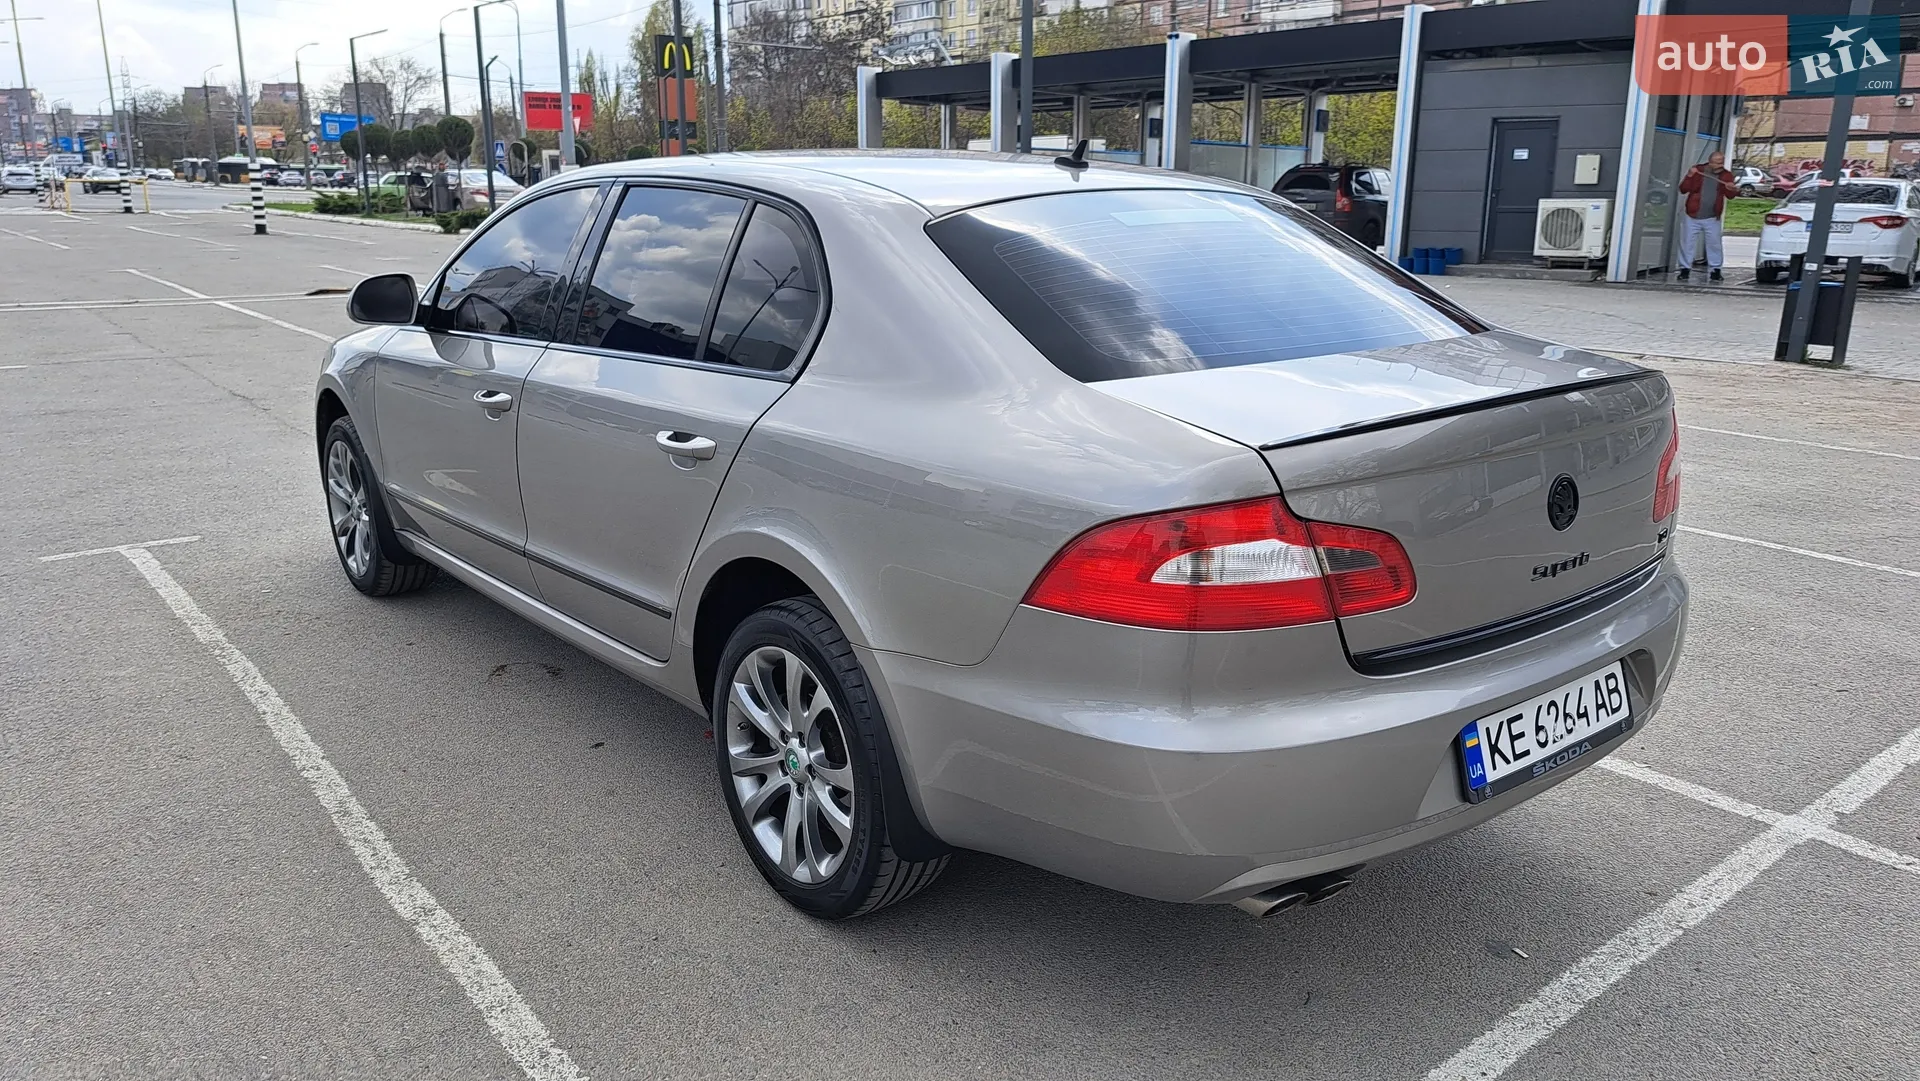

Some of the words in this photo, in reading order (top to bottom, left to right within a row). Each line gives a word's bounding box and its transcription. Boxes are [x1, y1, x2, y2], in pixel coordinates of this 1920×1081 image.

[1530, 551, 1590, 582] Superb
[1485, 713, 1530, 771] KE
[1534, 686, 1591, 749] 6264
[1594, 672, 1623, 722] AB
[1470, 763, 1484, 778] UA
[1532, 741, 1593, 777] ŠKODA
